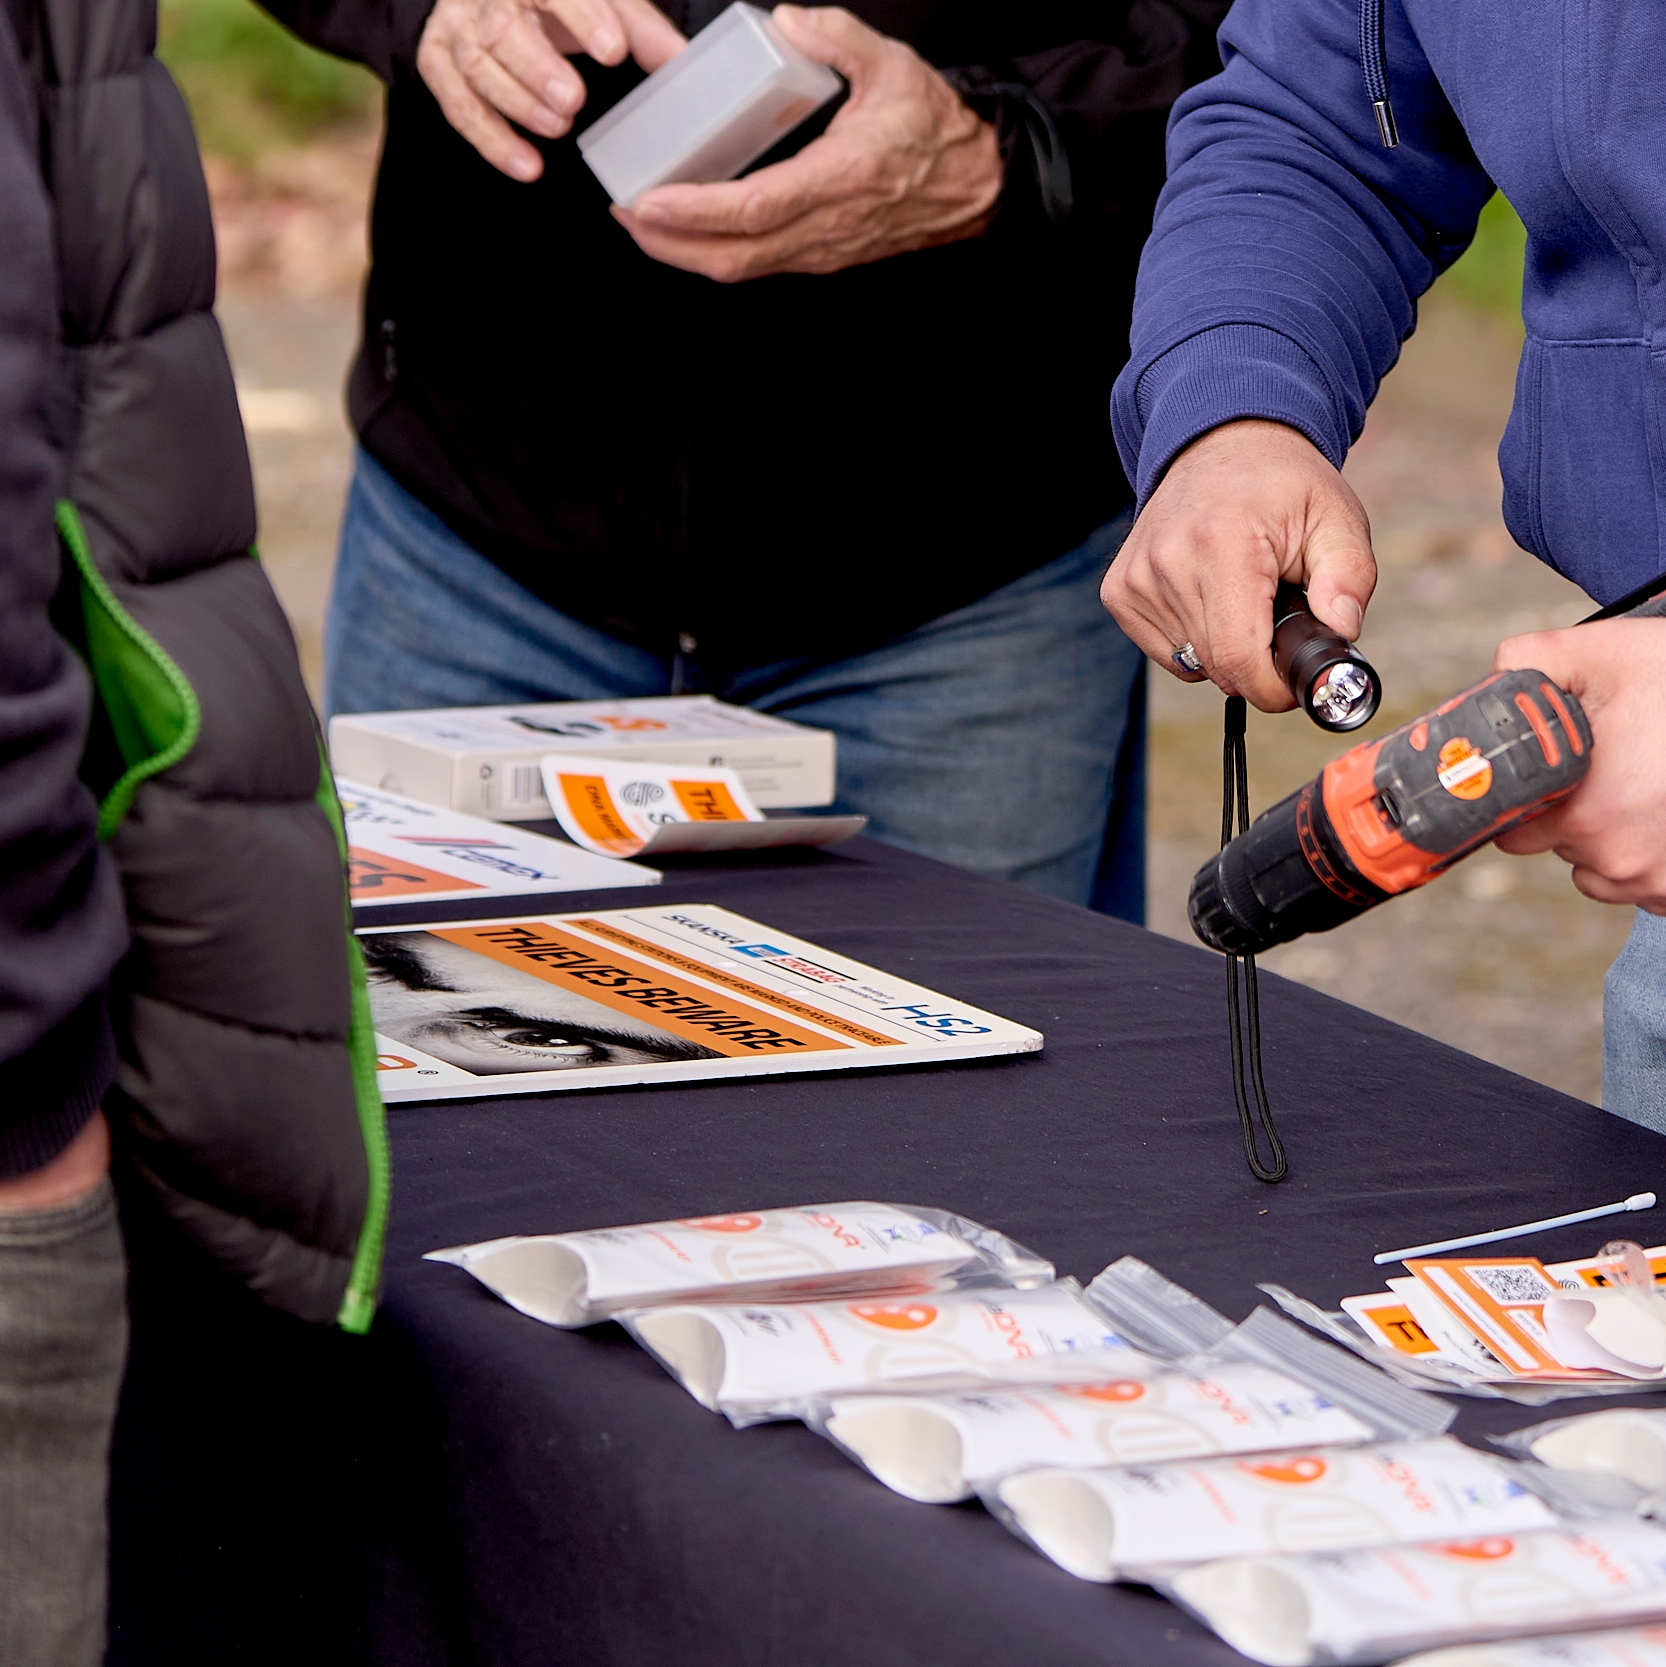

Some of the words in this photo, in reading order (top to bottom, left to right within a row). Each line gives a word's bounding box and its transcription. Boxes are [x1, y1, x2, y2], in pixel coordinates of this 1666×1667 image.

[663, 914, 746, 945] SKANSKA
[771, 956, 847, 984] STRABAG
[475, 927, 653, 987] THIEVES
[612, 986, 808, 1051] BEWARE
[807, 1011, 840, 1025] POLICE
[879, 1003, 993, 1038] HS2
